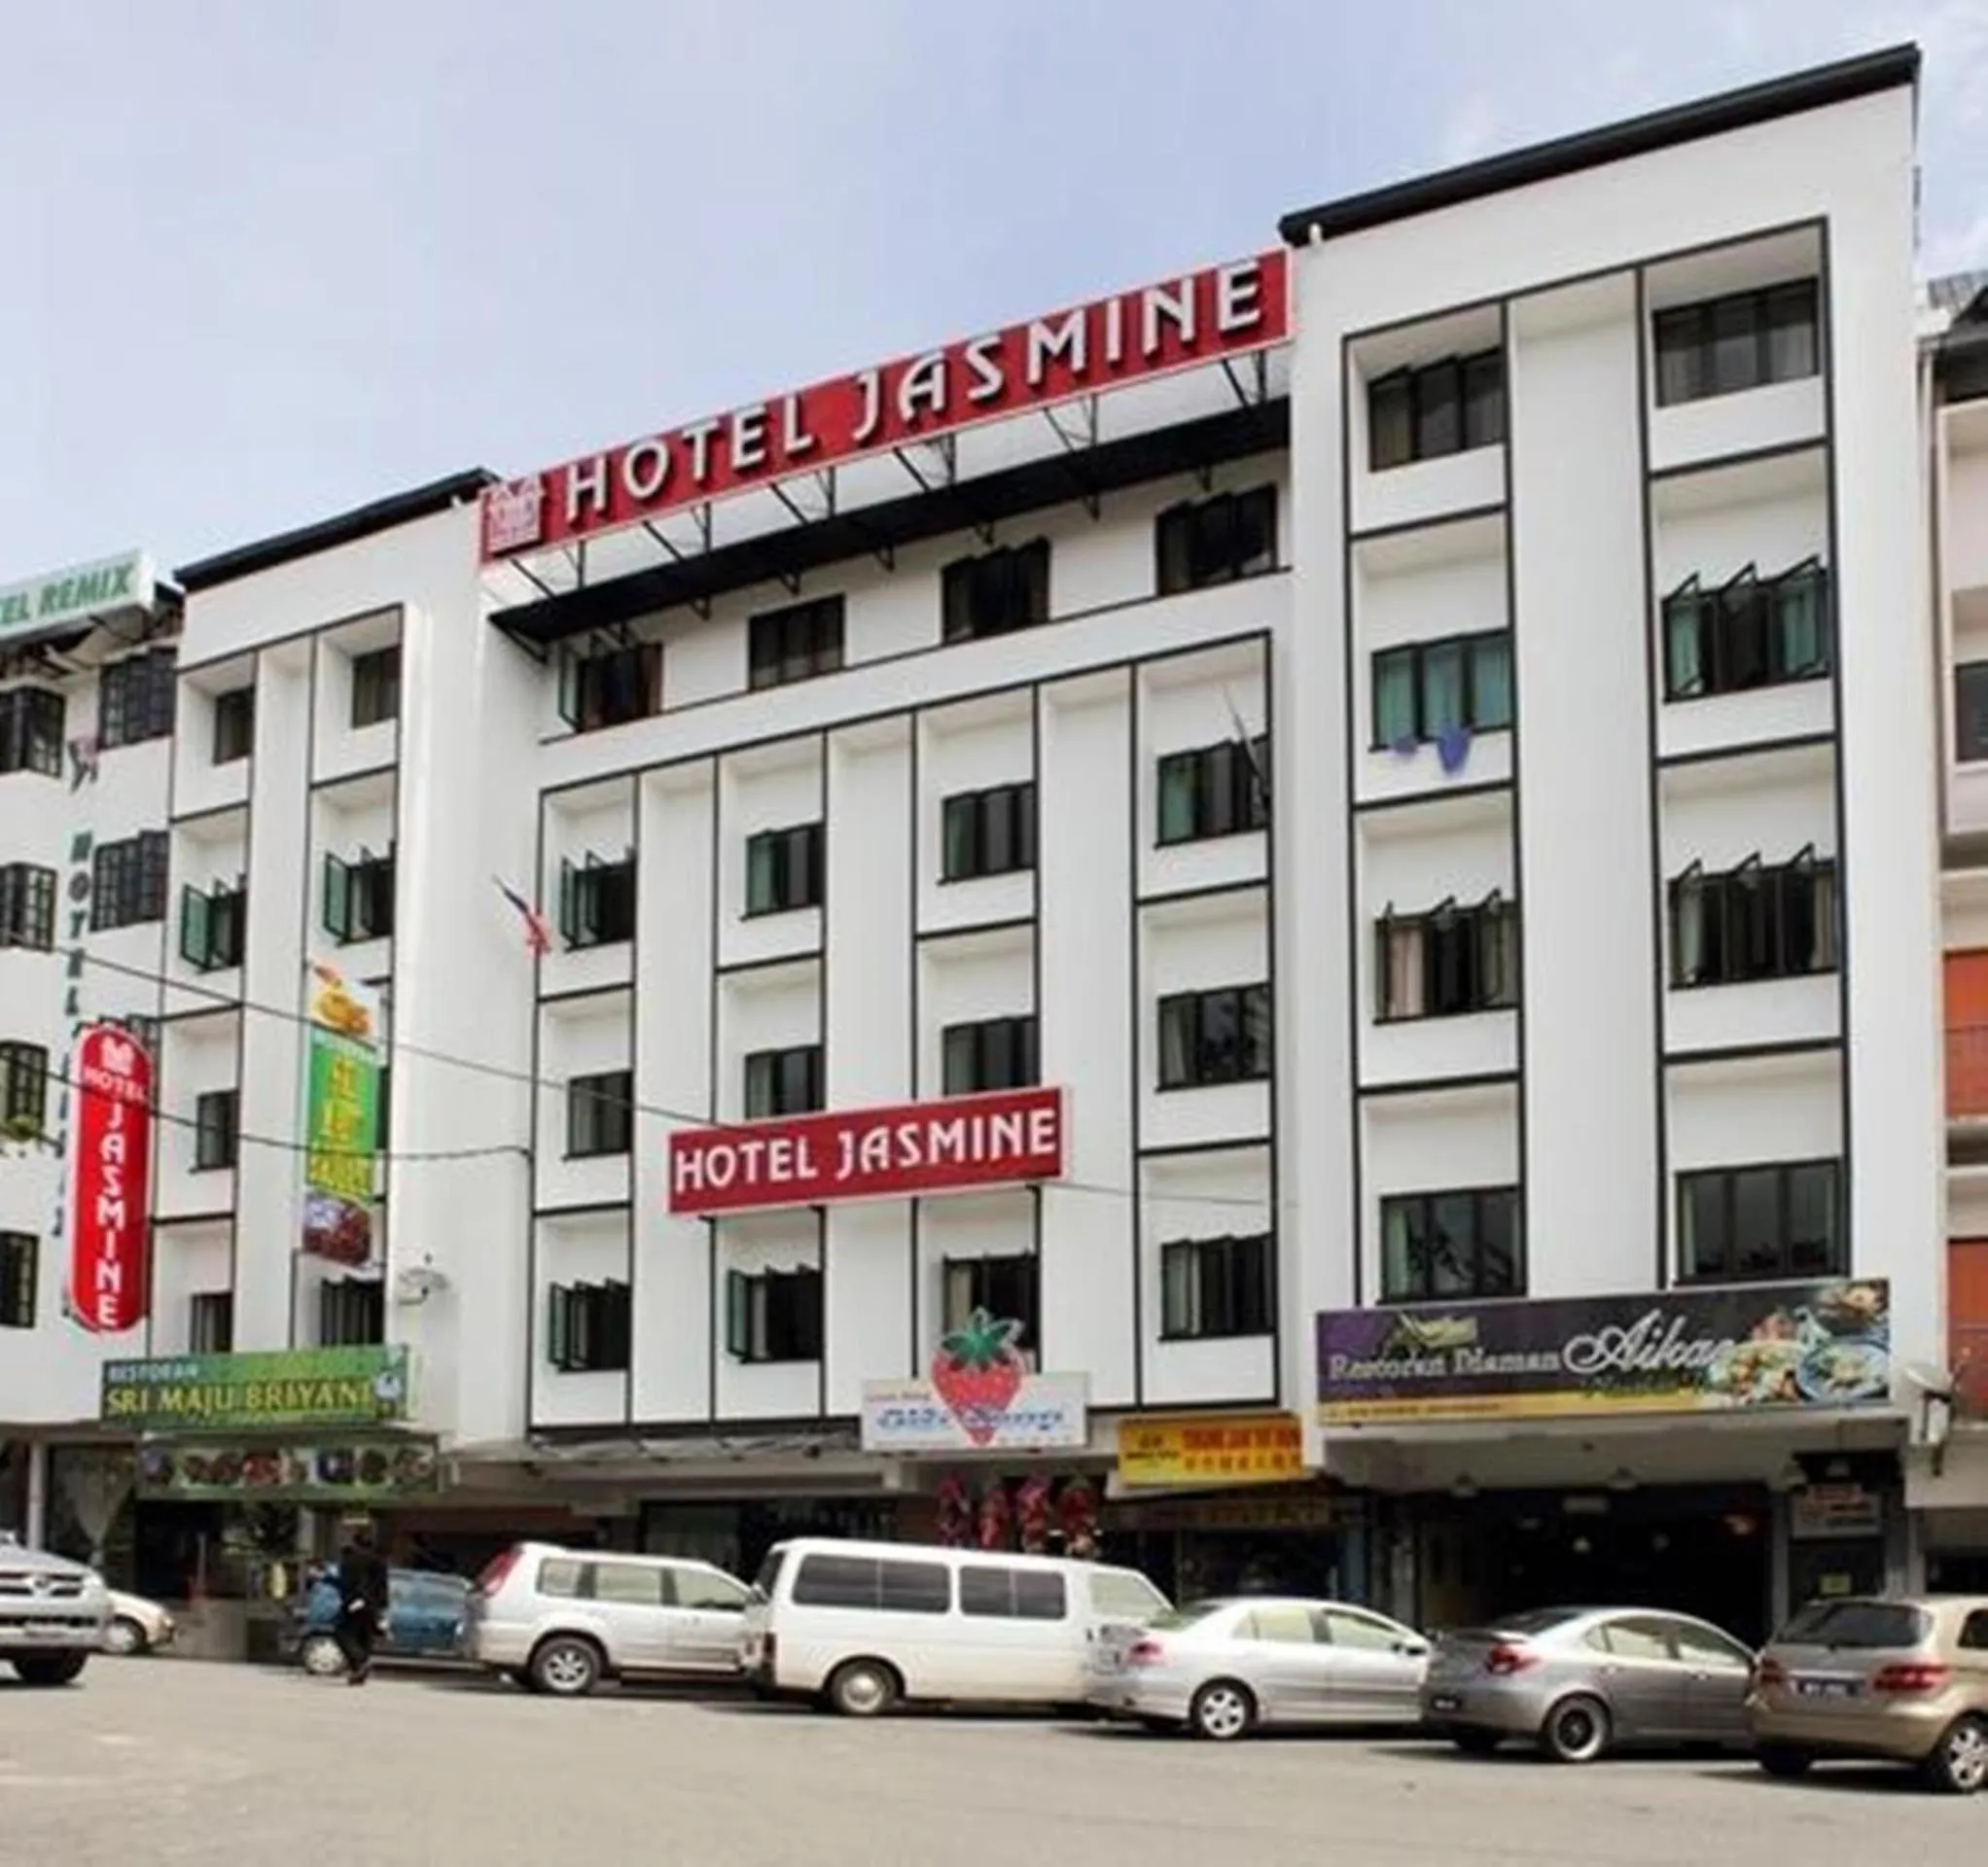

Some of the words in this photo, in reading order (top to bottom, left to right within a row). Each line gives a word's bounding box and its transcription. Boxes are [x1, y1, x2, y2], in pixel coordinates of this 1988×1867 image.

[564, 393, 813, 522] HOTEL
[852, 263, 1261, 440] JASMINE
[38, 564, 133, 616] REMIX
[84, 1067, 144, 1102] HOTEL
[675, 1136, 817, 1194] HOTEL
[834, 1109, 1057, 1181] JASMINE
[95, 1102, 127, 1326] JASMINE
[107, 1388, 148, 1416] SRI
[158, 1386, 234, 1417] MAJU
[245, 1379, 371, 1410] BRIYANI
